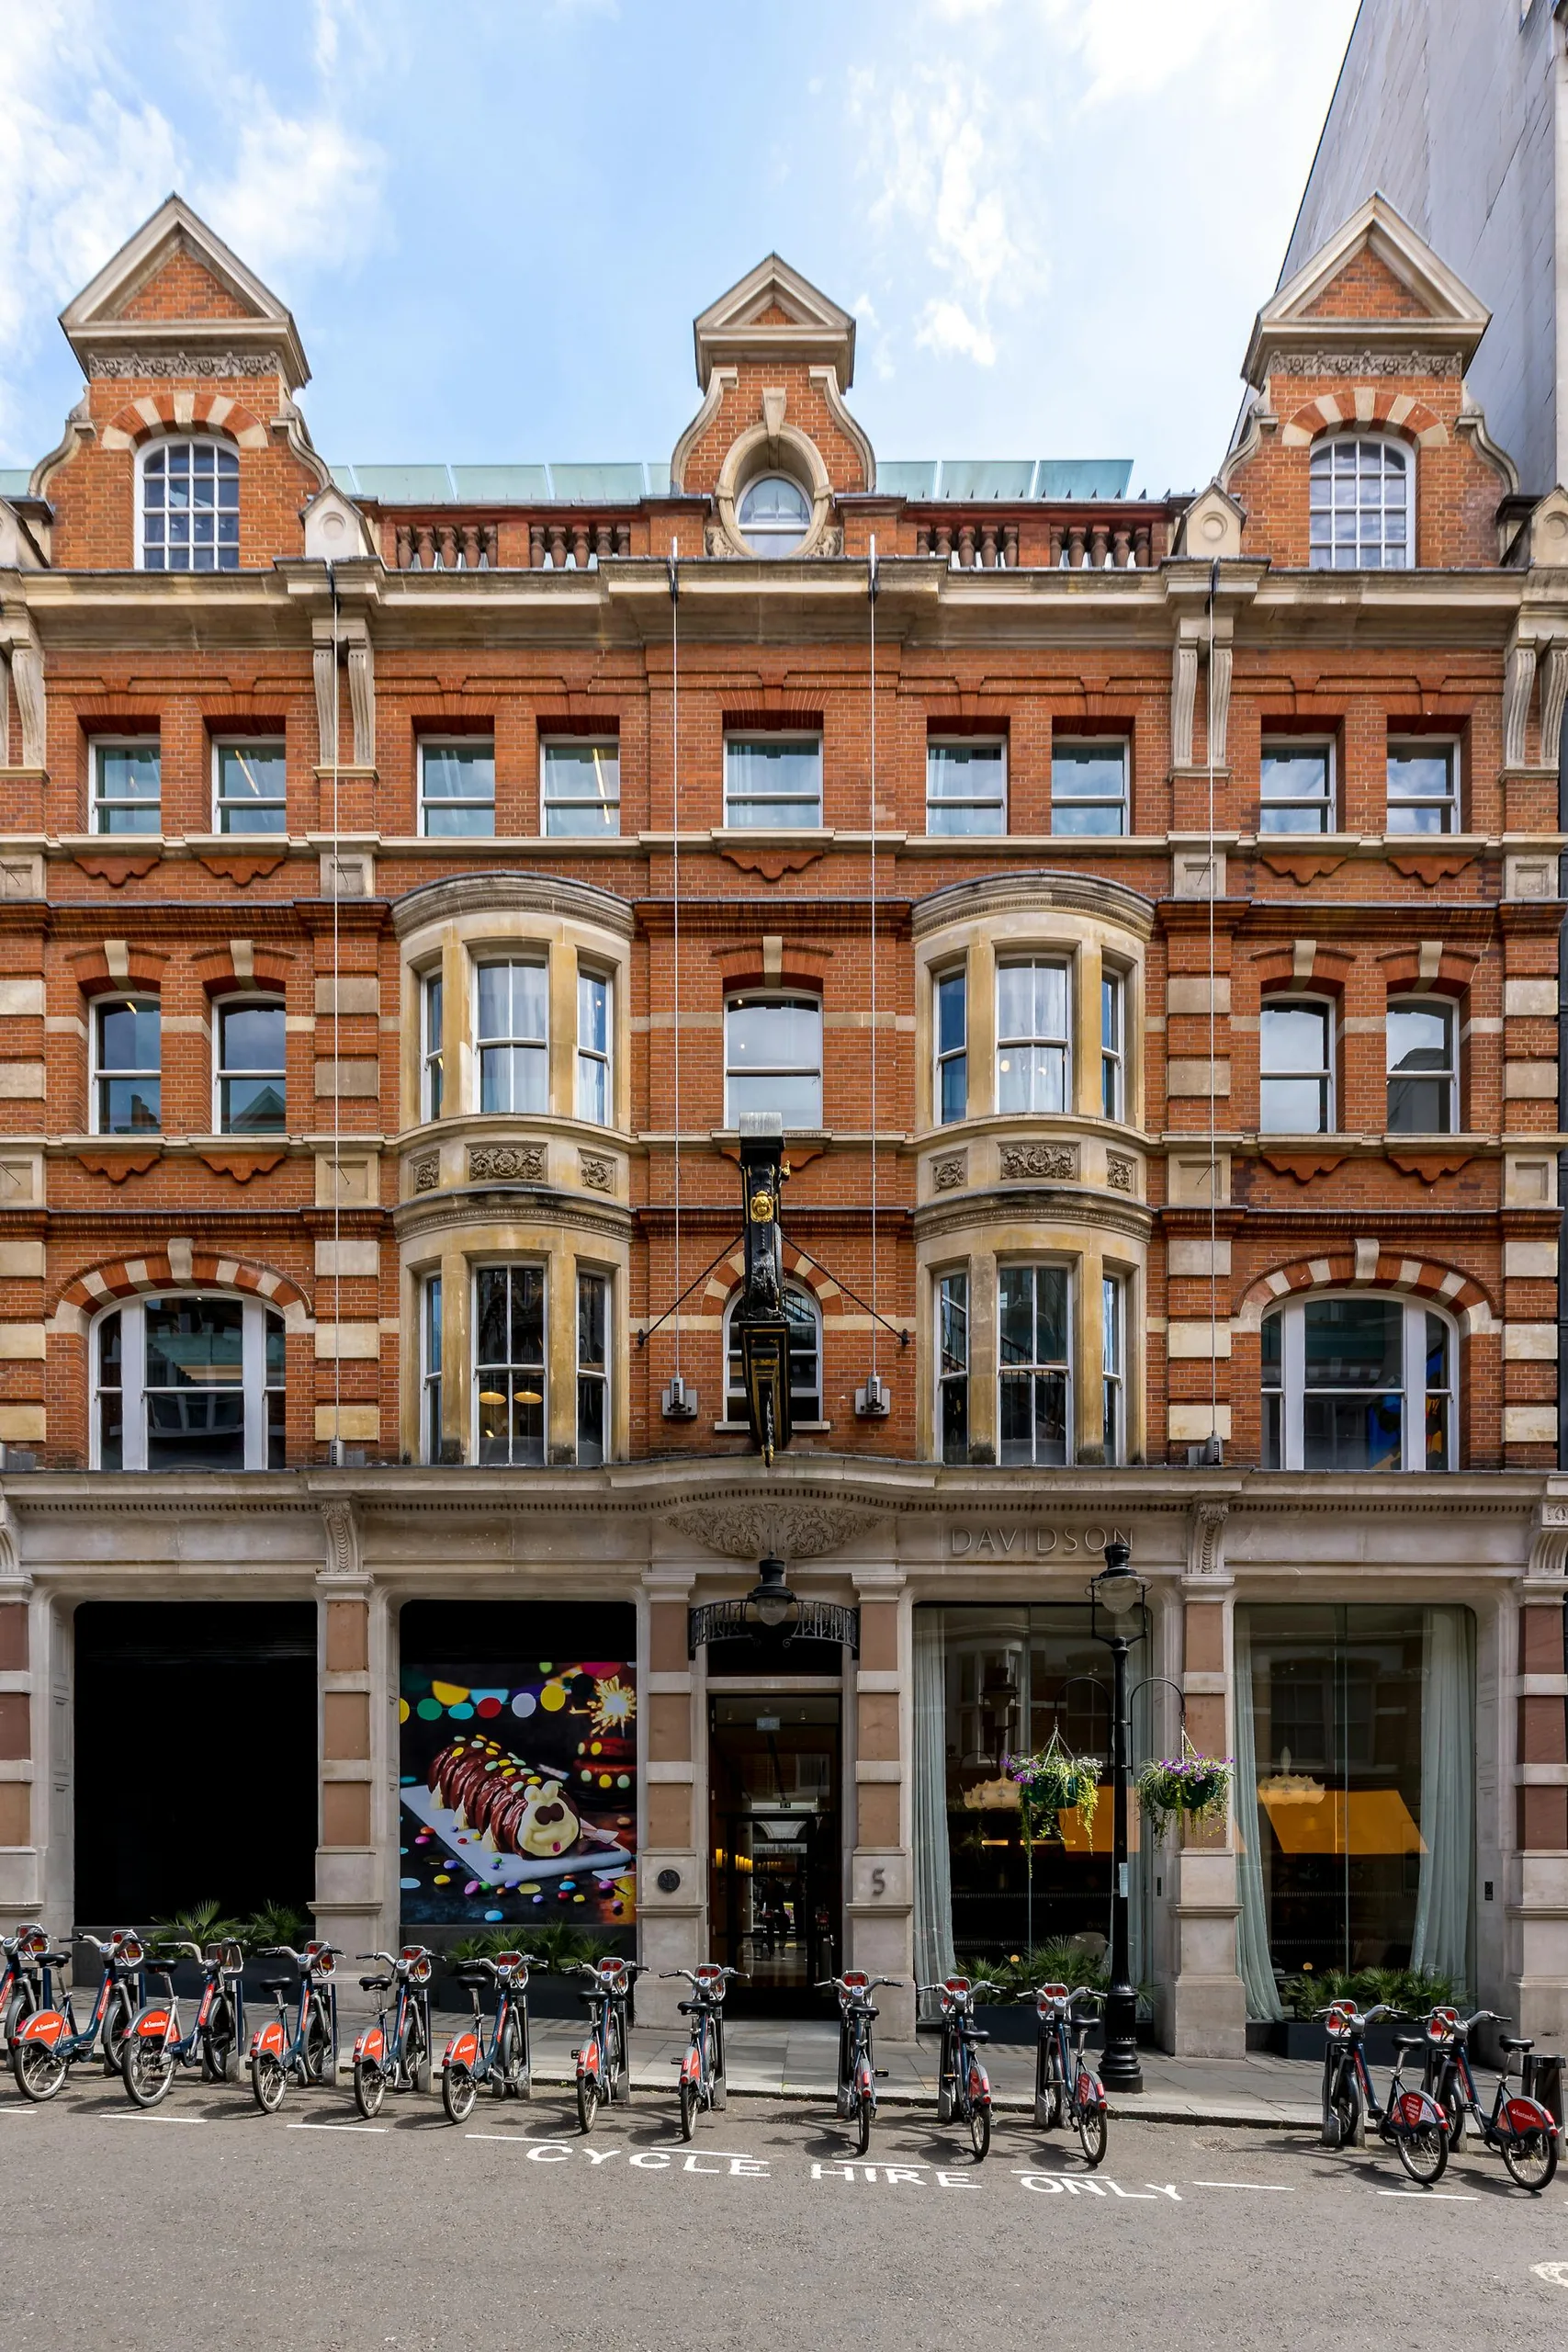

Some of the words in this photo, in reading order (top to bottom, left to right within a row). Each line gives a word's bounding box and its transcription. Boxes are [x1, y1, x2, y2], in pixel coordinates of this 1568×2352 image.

[951, 1526, 1134, 1553] DAVIDSON
[871, 1867, 886, 1897] 5
[1515, 2109, 1537, 2122] Santander
[525, 2145, 772, 2177] CYCLE
[810, 2163, 983, 2189] HIRE
[1021, 2177, 1183, 2201] ONLY
